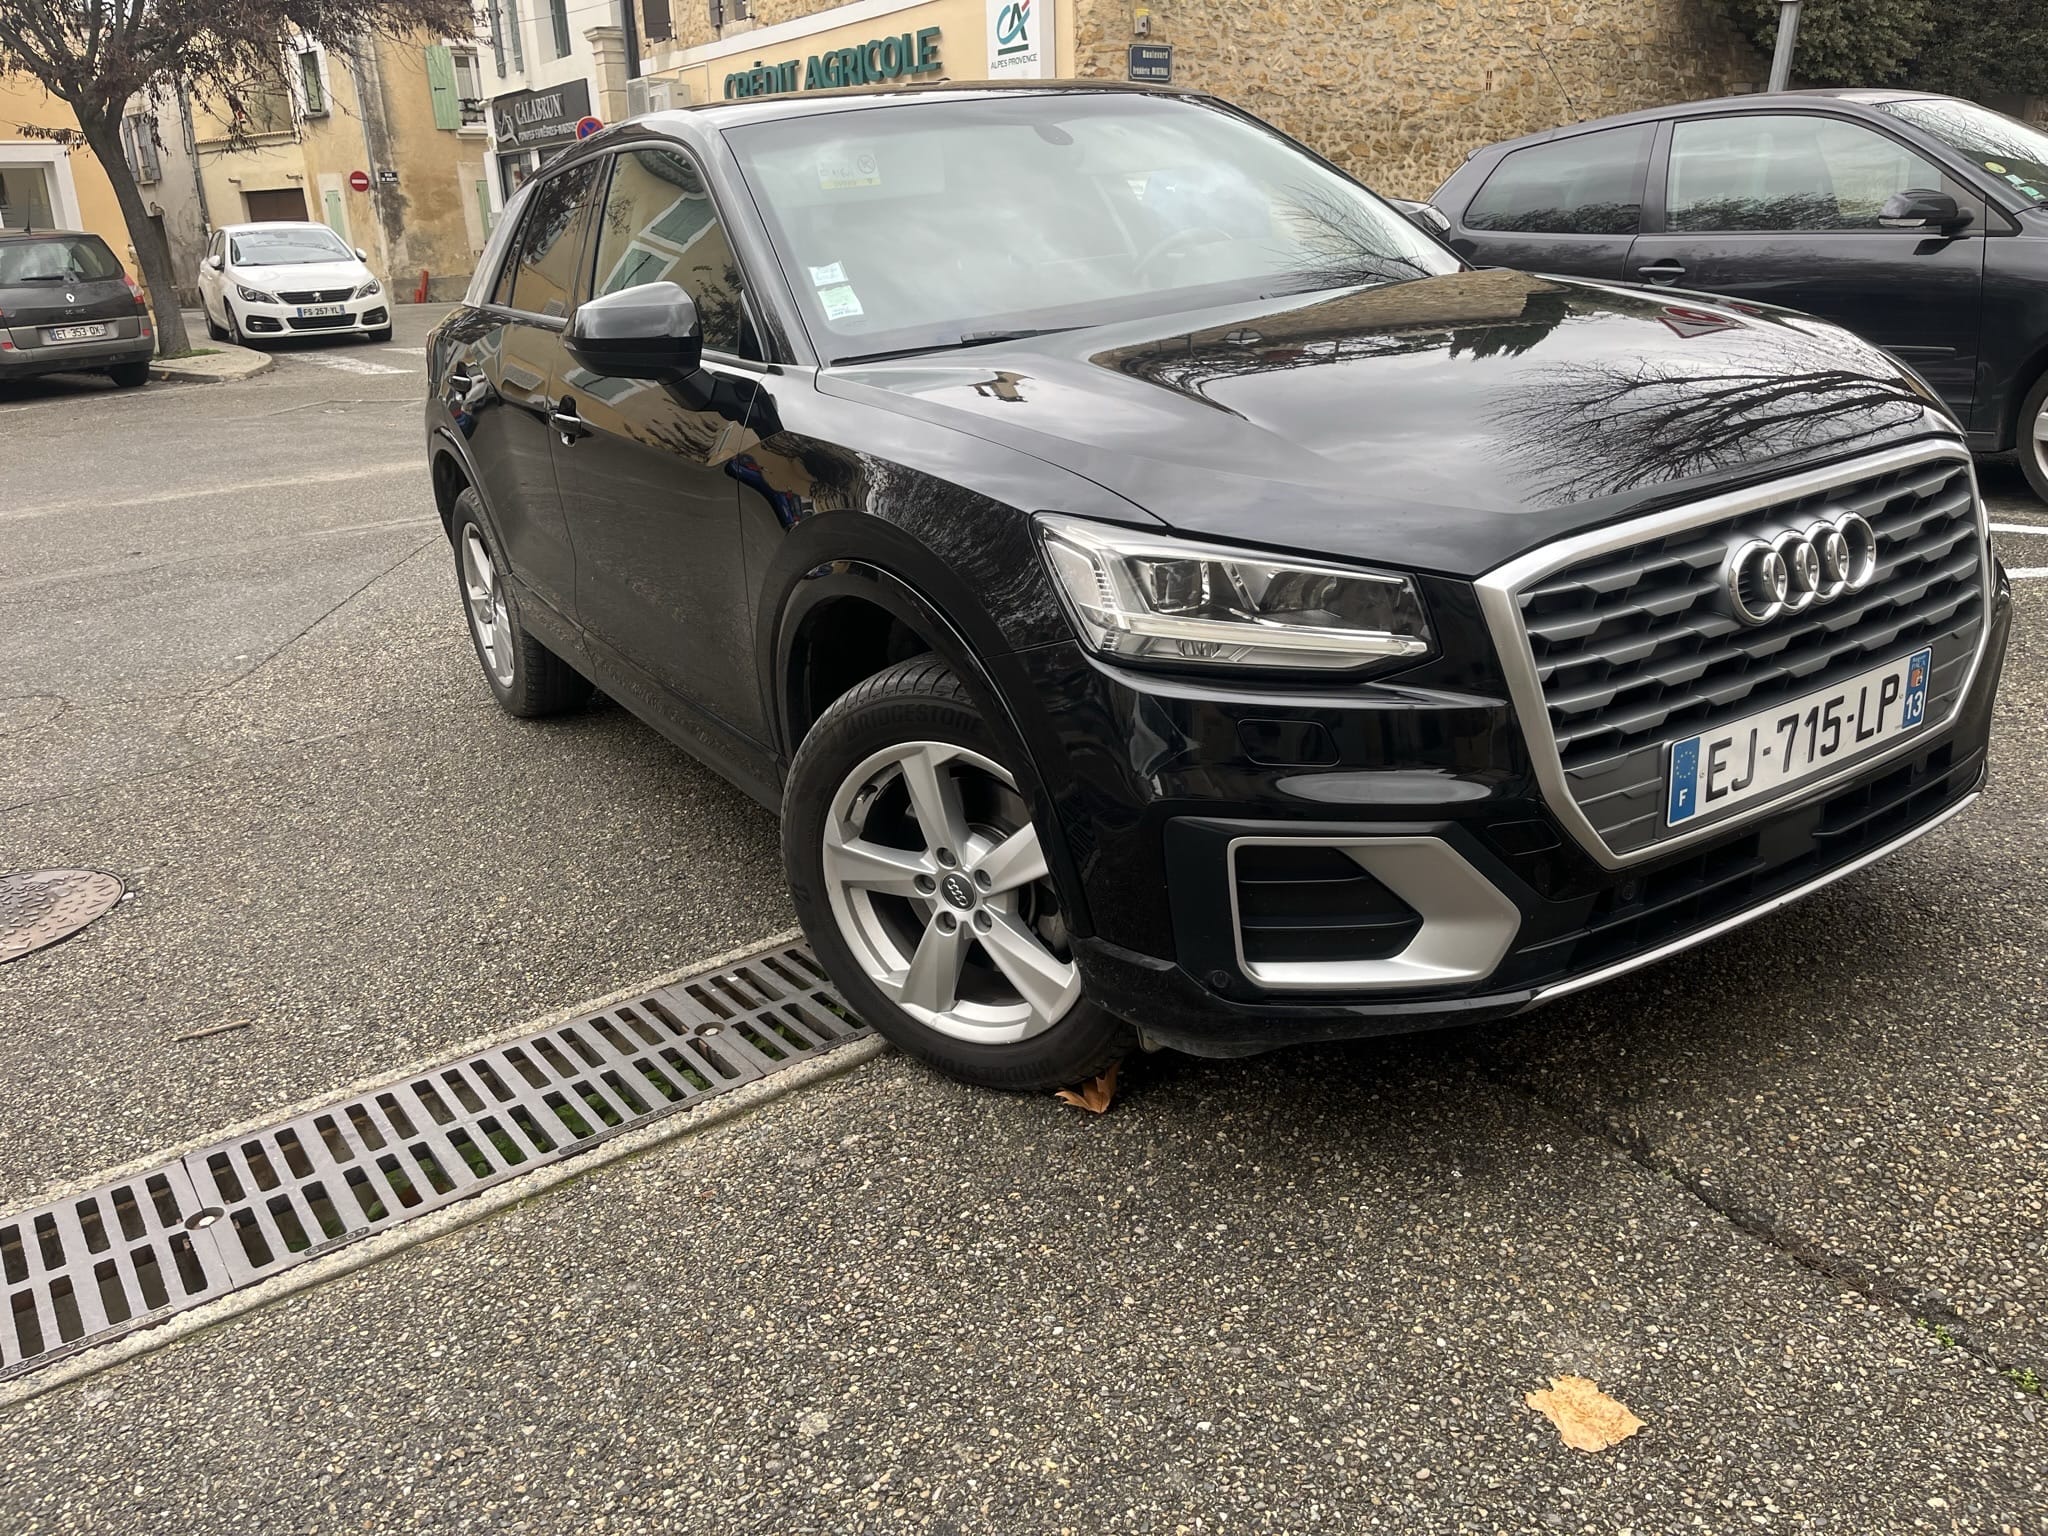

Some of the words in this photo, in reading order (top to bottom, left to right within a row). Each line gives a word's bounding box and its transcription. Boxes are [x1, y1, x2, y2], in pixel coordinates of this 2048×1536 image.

[804, 26, 942, 91] AGRICOLE
[990, 59, 1008, 70] ALPES
[1008, 53, 1038, 66] PROVENCE
[1906, 691, 1923, 719] 13
[1705, 673, 1901, 803] EJ-715-LP
[1678, 788, 1688, 807] F
